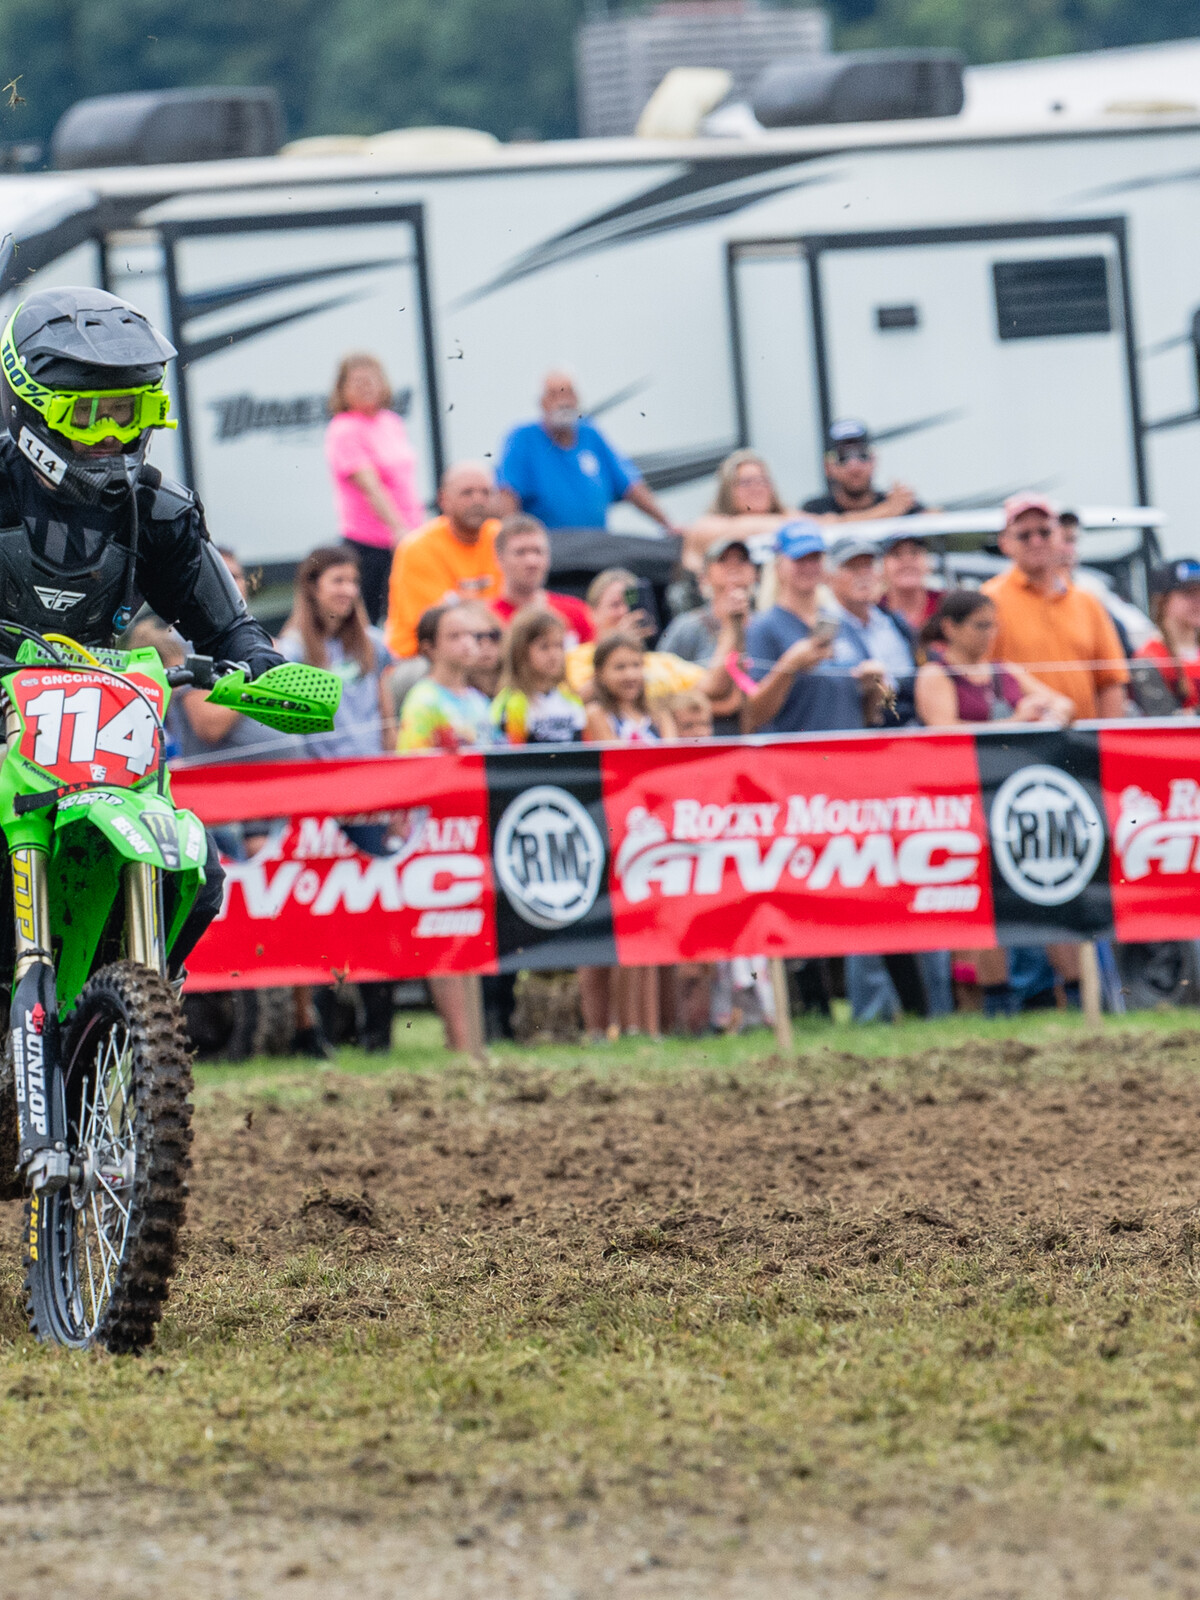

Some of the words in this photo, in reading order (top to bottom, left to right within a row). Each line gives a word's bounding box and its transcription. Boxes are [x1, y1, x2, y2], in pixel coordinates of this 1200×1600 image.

[1, 342, 49, 408] 100%
[26, 439, 59, 474] 114
[37, 650, 125, 668] RNTAL
[41, 673, 160, 698] GNCCRACINGCOM
[25, 686, 160, 776] 114
[672, 798, 780, 842] ROCKY
[784, 793, 973, 837] MOUNTAIN
[25, 1009, 49, 1136] DUNLOP
[29, 1196, 40, 1262] DUNL
